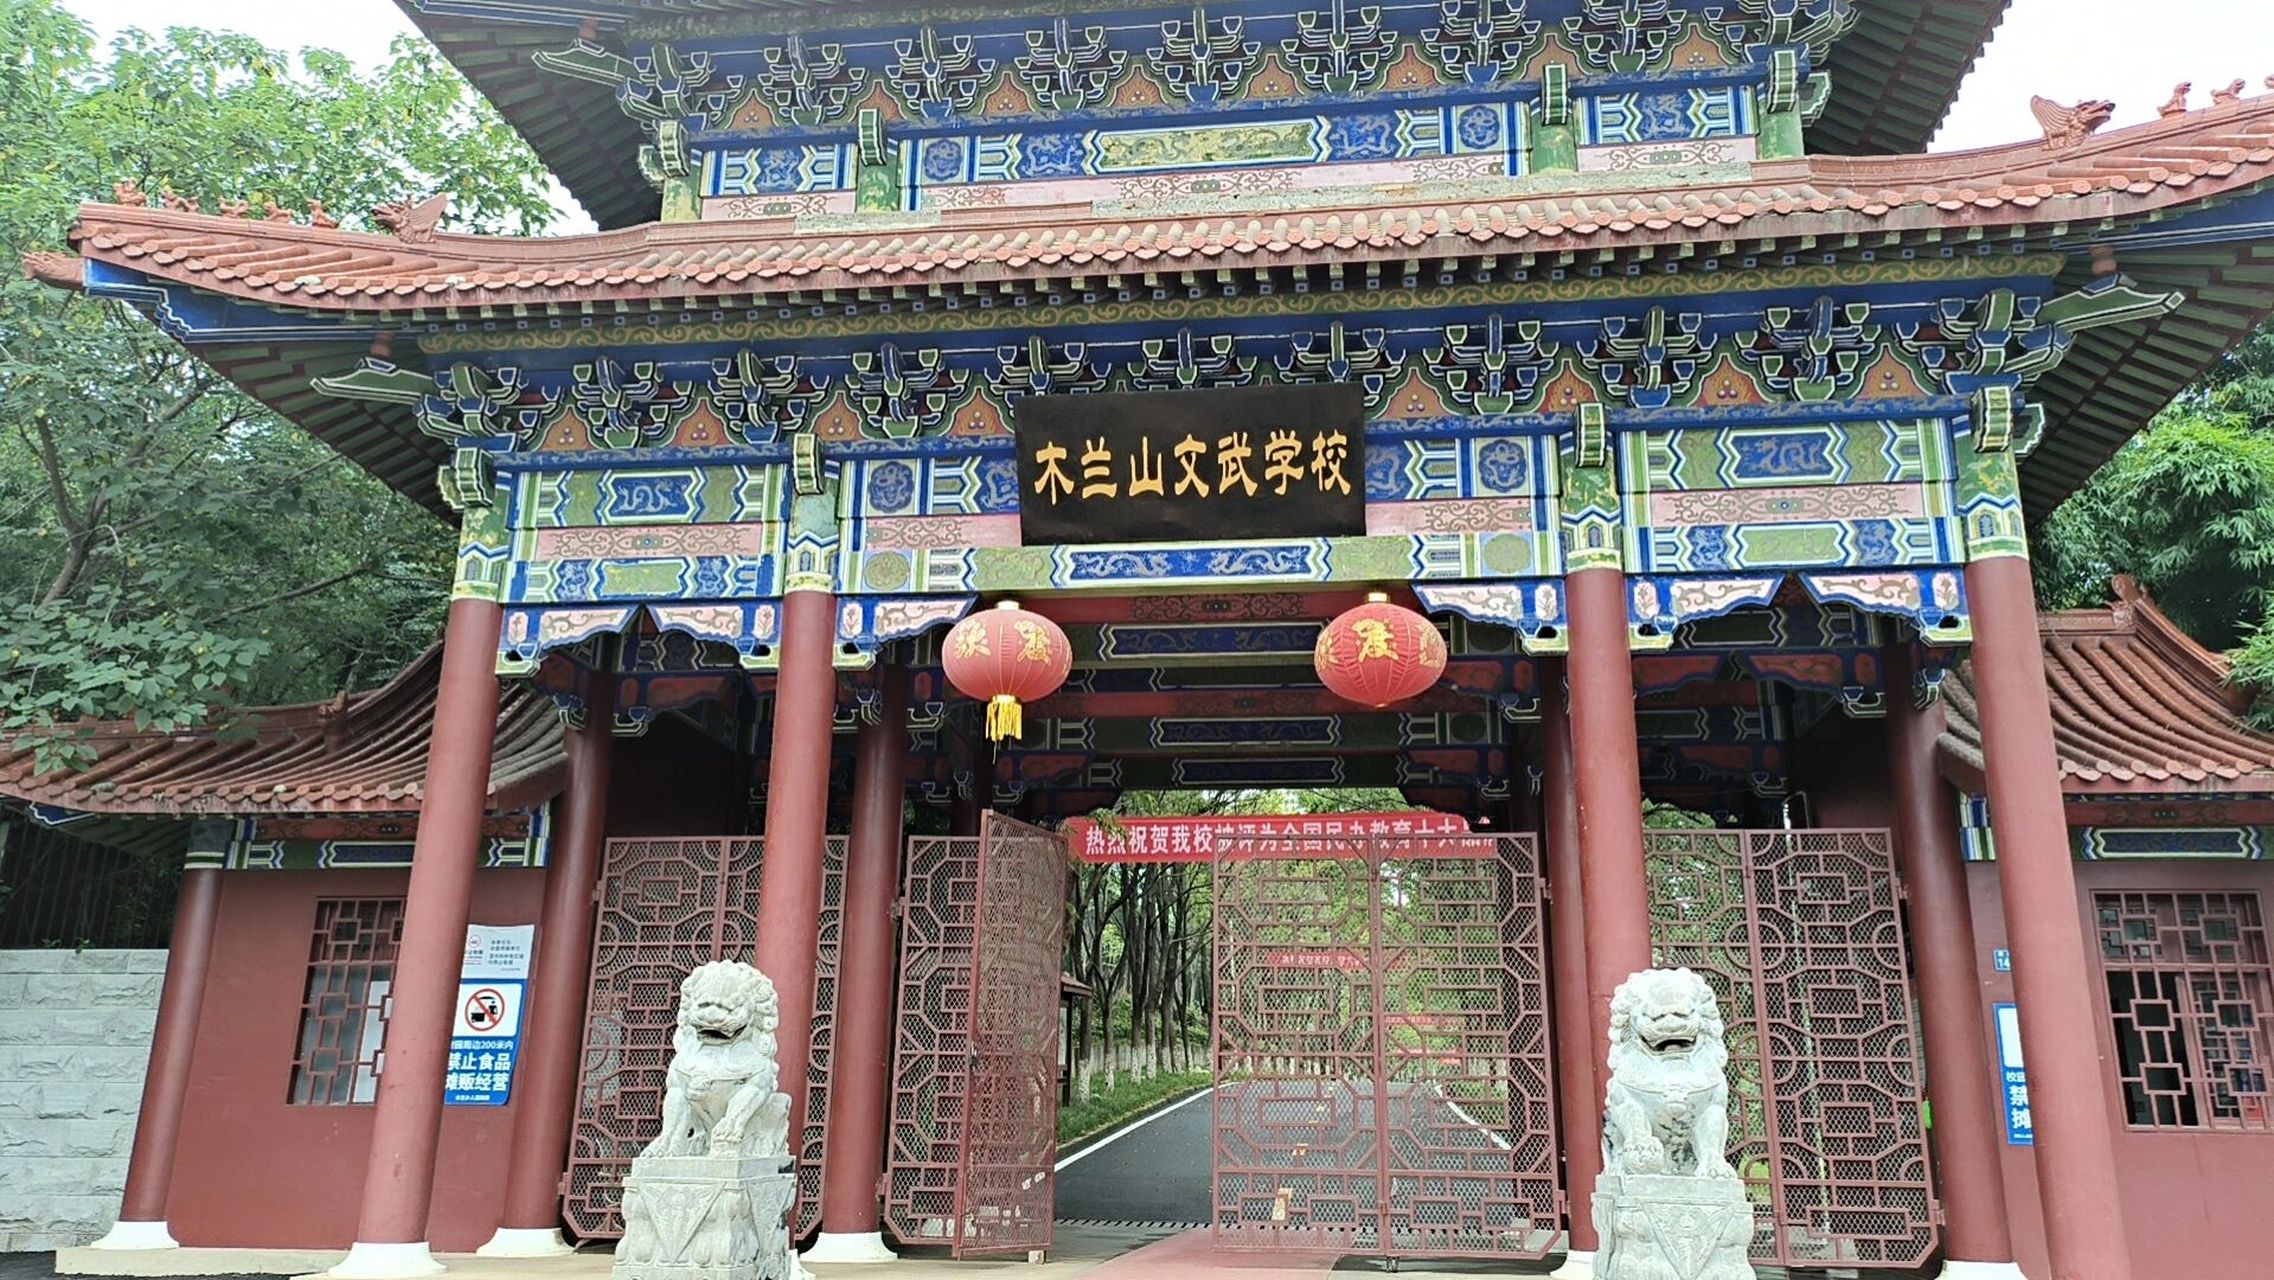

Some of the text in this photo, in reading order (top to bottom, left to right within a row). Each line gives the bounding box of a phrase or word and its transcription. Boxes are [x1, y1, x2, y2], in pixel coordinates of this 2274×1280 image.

[1033, 429, 1352, 506] 木兰山文武学校
[451, 1040, 514, 1050] 园周边200米内
[448, 1052, 511, 1071] 禁止食品
